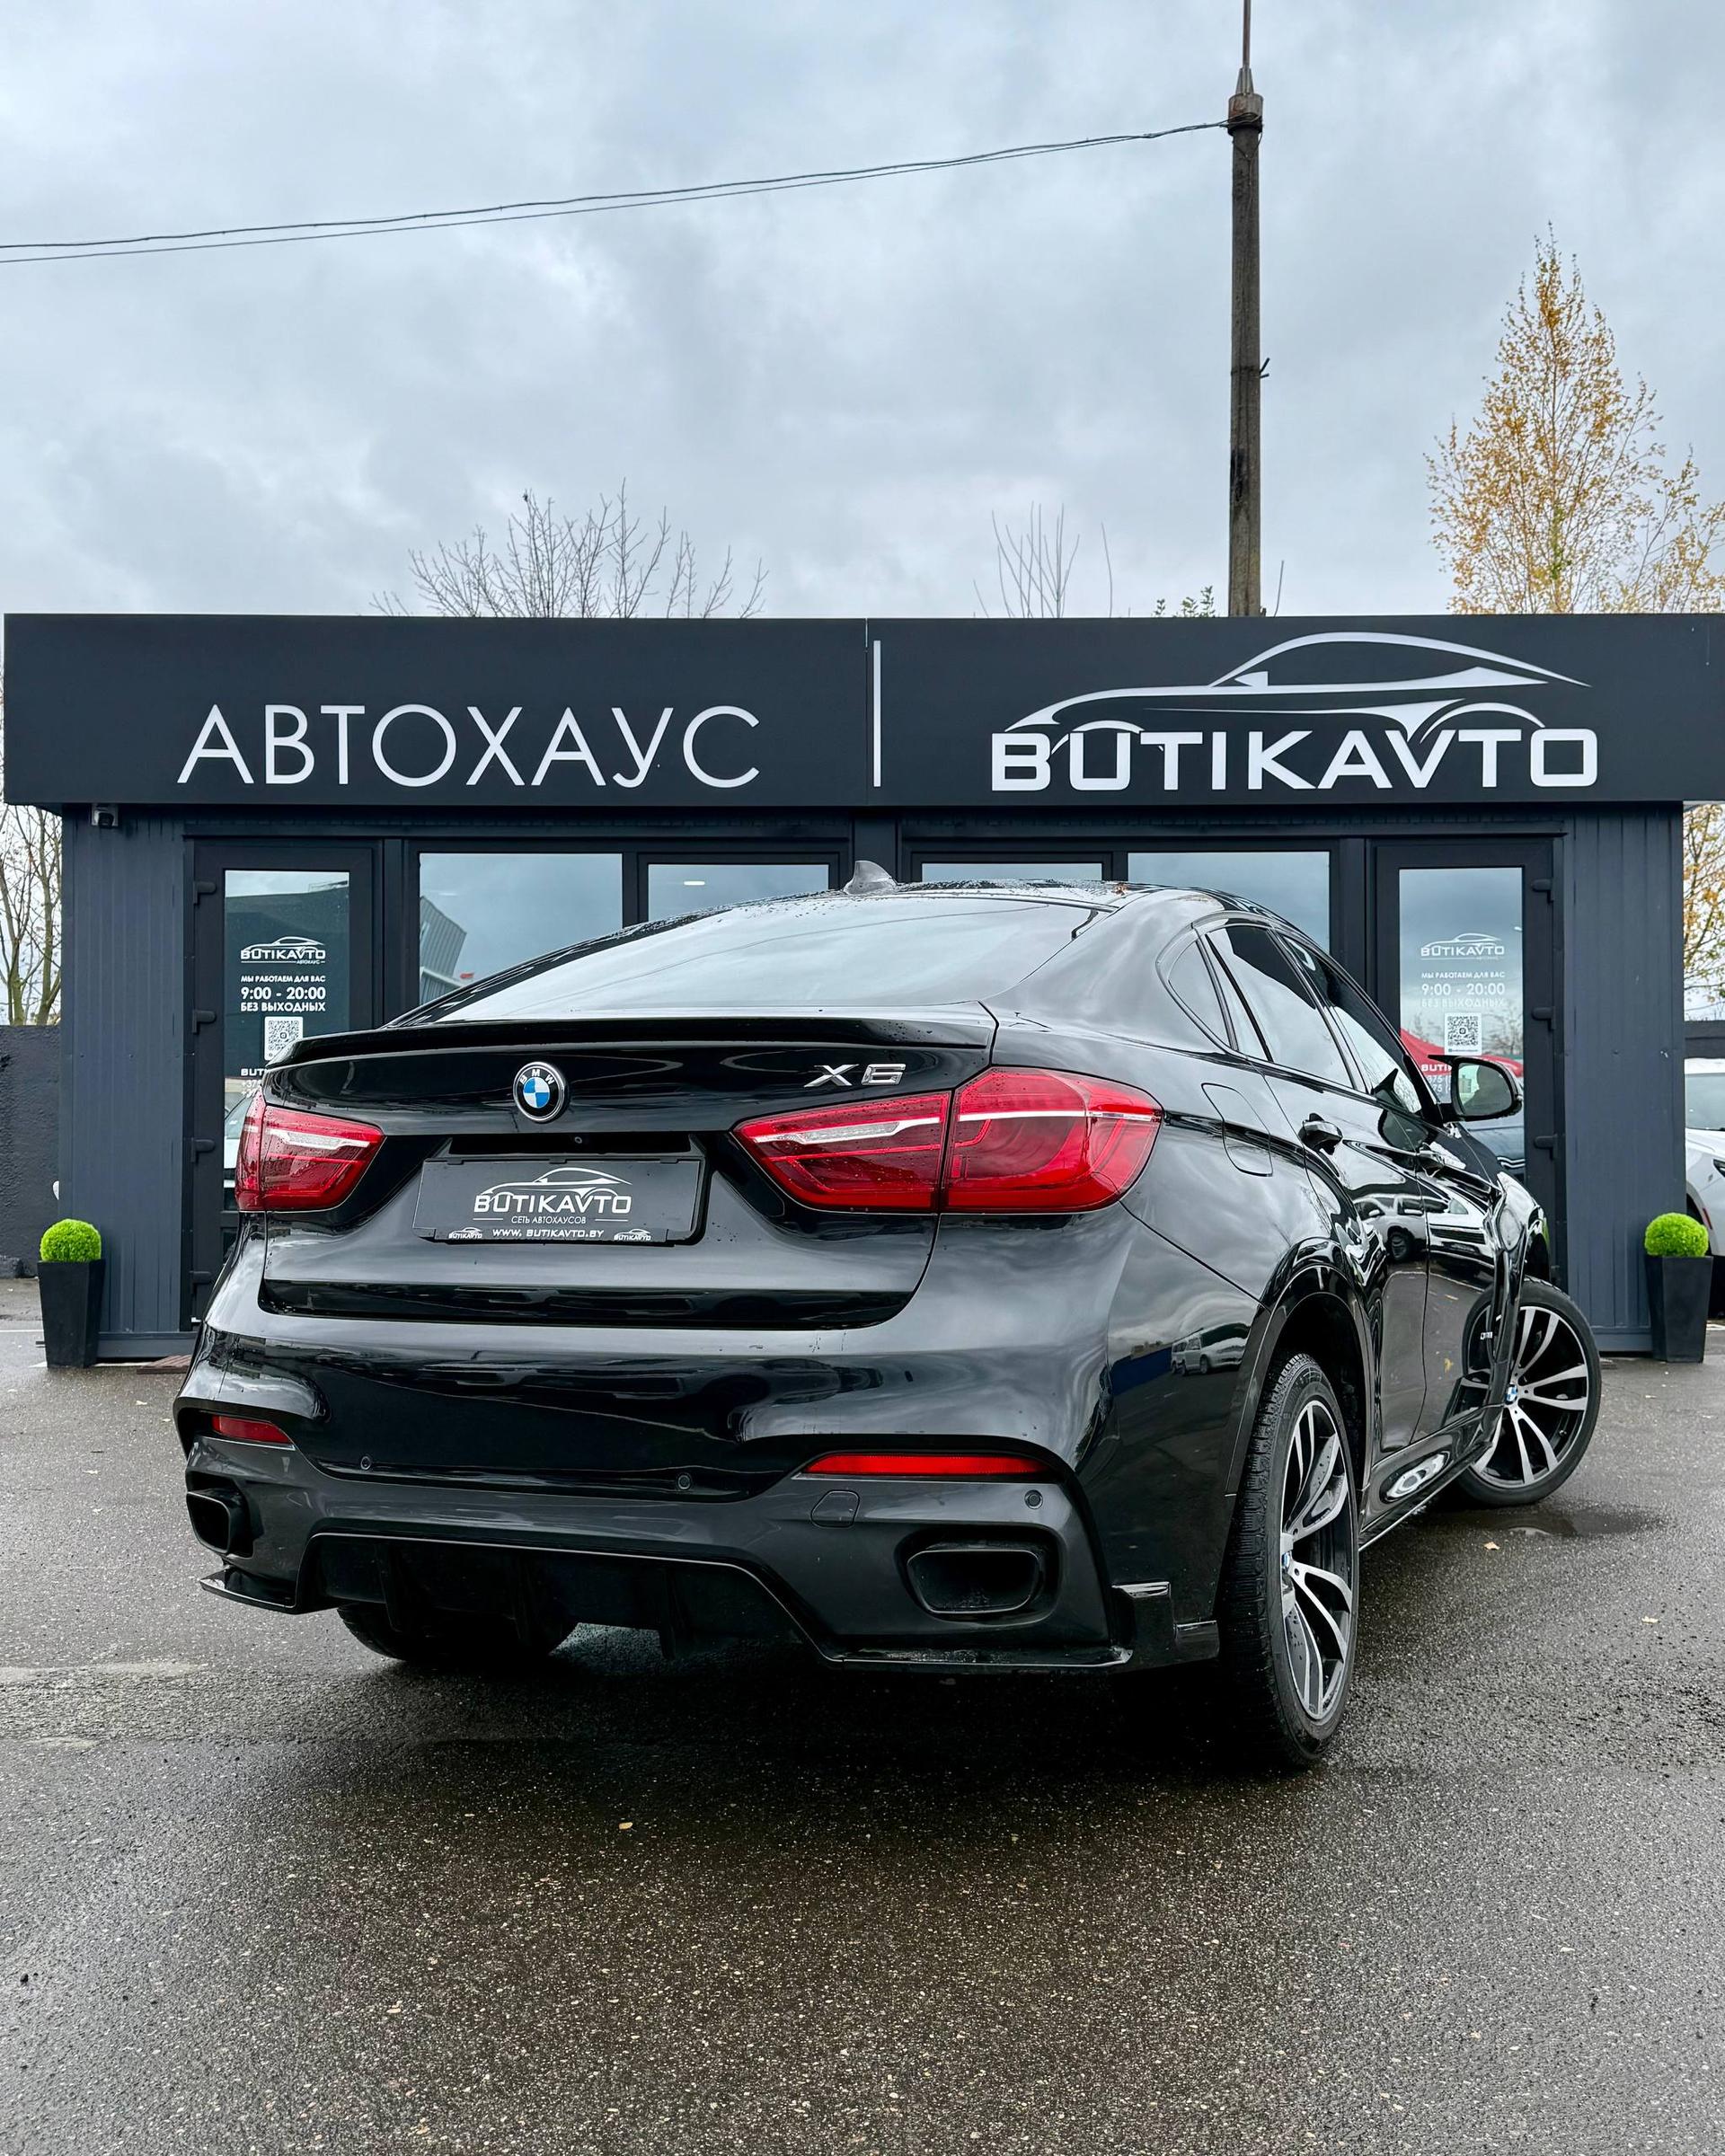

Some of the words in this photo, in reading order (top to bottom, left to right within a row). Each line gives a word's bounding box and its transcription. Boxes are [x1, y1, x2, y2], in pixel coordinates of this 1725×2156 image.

[177, 703, 760, 789] АВТОХАУС
[992, 729, 1598, 791] BUTIKAVTO
[241, 949, 326, 959] BUTIKAVTO
[1420, 946, 1505, 957] BUTIKAVTO
[241, 986, 271, 1000] 9:00
[286, 986, 326, 1000] 20:00
[1421, 983, 1451, 995] 9:00
[1465, 983, 1505, 995] 20:00
[241, 1002, 259, 1012] БЕЗ
[261, 1002, 326, 1012] ВЫХОДНЫХ
[1421, 998, 1438, 1008] БЕЗ
[1441, 997, 1505, 1007] ВЫХОДНЫХ
[241, 1068, 267, 1076] BUT
[519, 1068, 555, 1085] BMW
[803, 1063, 907, 1087] X6
[473, 1194, 632, 1214] BUTIKAVTO
[511, 1215, 530, 1224] СЕТЬ
[532, 1215, 586, 1224] АВТОХАУСОВ
[526, 1229, 605, 1238] BUTIKAVTO.BY
